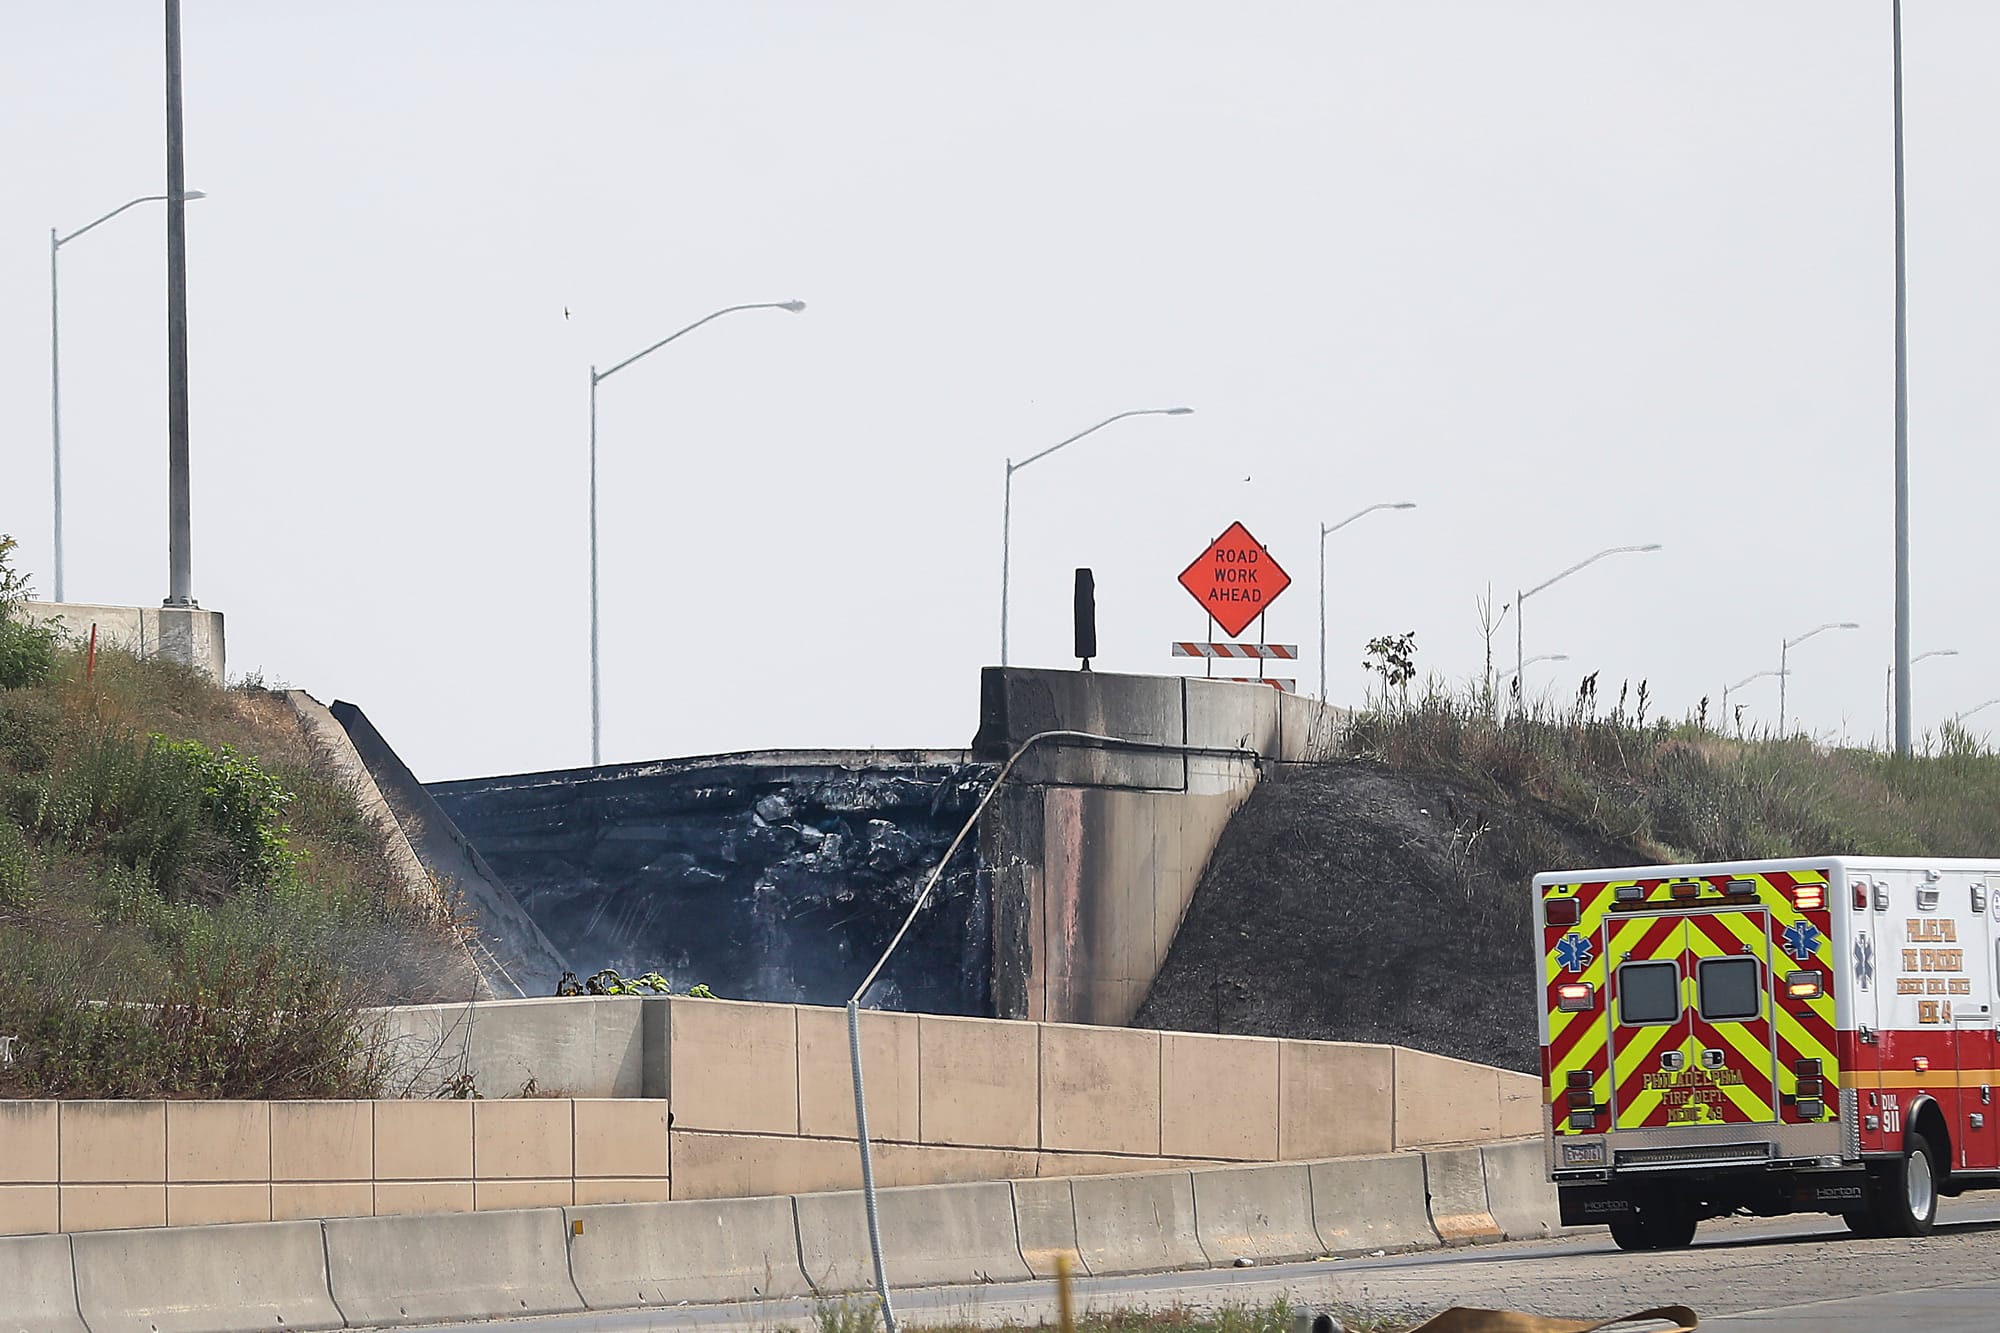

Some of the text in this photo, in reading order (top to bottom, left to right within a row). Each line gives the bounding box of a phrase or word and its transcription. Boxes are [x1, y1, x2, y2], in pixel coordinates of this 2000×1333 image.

[1215, 549, 1258, 563] ROAD
[1214, 568, 1258, 583] WORK
[1208, 588, 1262, 602] AHEAD
[1643, 1069, 1744, 1089] PHILADELPHIA
[1663, 1091, 1689, 1105] FIRE
[1881, 1094, 1899, 1110] DIAL
[1667, 1106, 1723, 1121] MEDIC 49
[1883, 1111, 1900, 1132] 911
[1816, 1187, 1861, 1196] Horton
[1585, 1200, 1628, 1209] Horton
